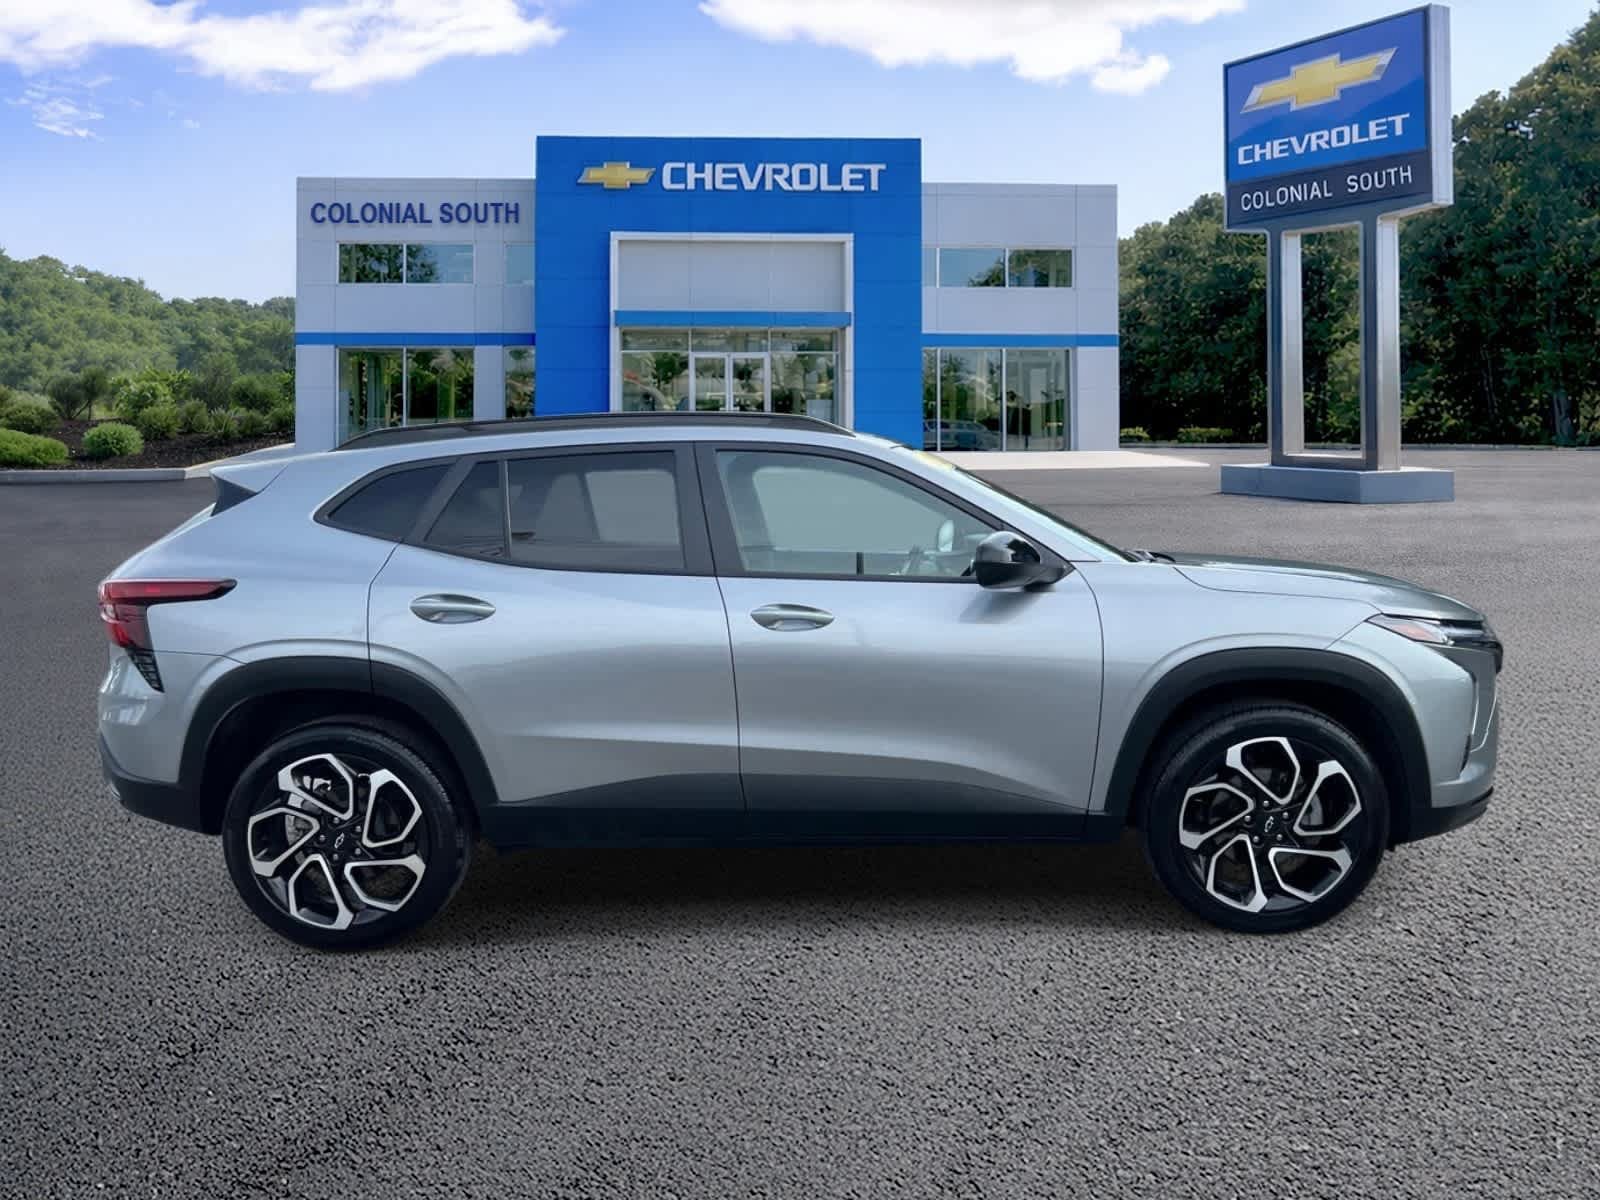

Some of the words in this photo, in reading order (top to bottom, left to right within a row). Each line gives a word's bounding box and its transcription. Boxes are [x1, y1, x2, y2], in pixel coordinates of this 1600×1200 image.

[1238, 113, 1410, 165] CHEVROLET
[661, 162, 886, 192] CHEVROLET
[1241, 180, 1333, 211] COLONIAL
[1347, 165, 1412, 193] SOUTH
[310, 202, 433, 225] COLONIAL
[439, 202, 520, 225] SOUTH
